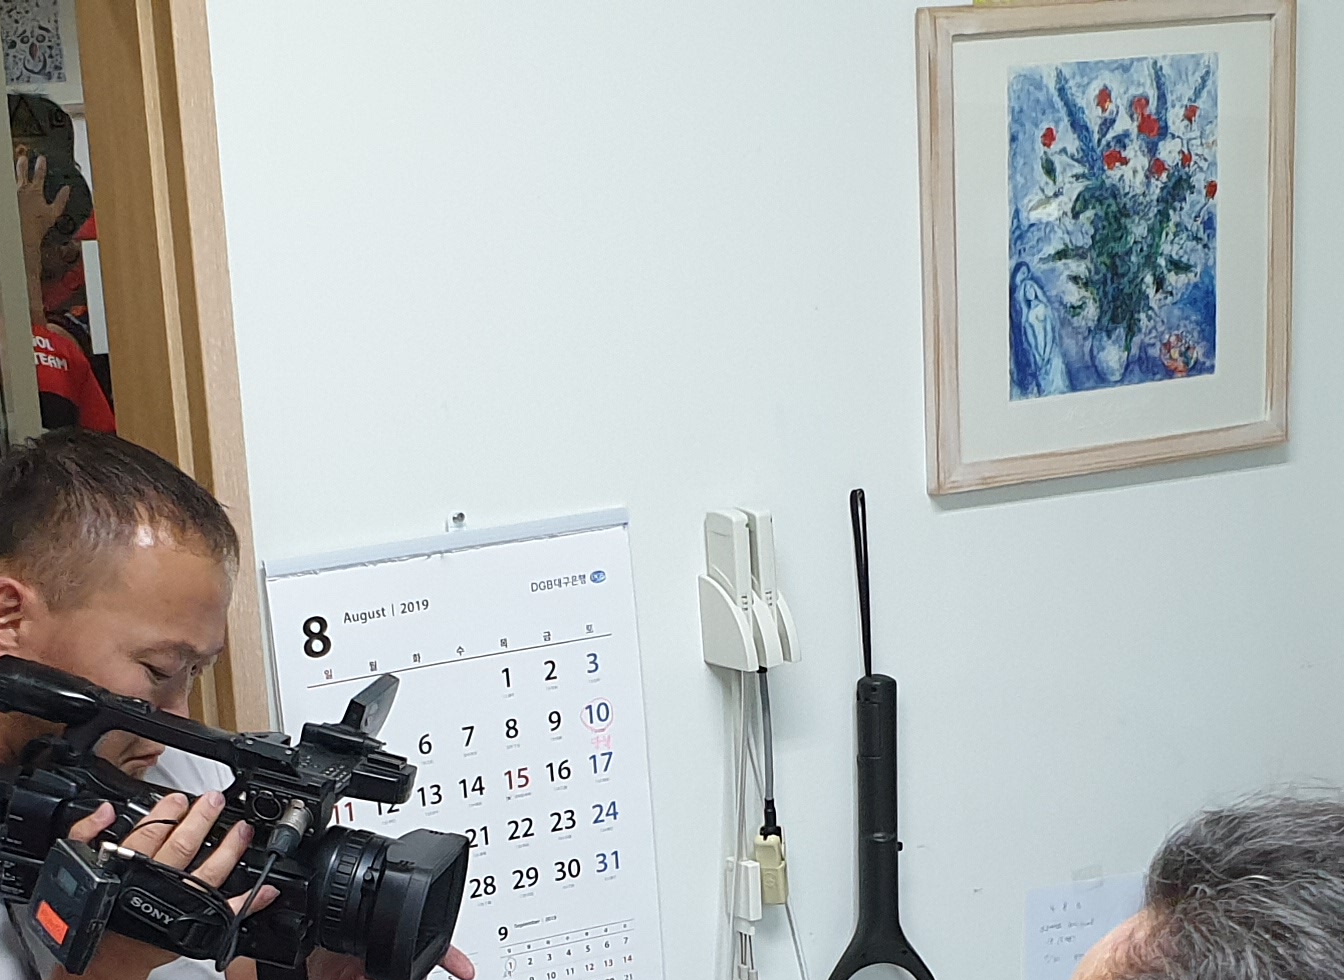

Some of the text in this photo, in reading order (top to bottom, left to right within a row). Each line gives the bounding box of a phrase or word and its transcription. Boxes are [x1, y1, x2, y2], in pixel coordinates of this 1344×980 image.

[531, 574, 586, 592] DGB대구은행
[344, 599, 429, 624] August 2019
[303, 616, 331, 658] 8
[456, 646, 465, 656] 수
[543, 631, 551, 641] 금
[501, 652, 599, 688] 1 2 3
[418, 733, 433, 755] 6
[461, 725, 475, 747] 7
[505, 718, 519, 739] 8
[548, 710, 562, 732] 9
[584, 702, 610, 725] 10
[332, 801, 354, 825] 11
[416, 784, 443, 807] 13
[458, 775, 486, 799] 14
[504, 767, 530, 790] 15
[545, 759, 572, 782] 16
[588, 751, 613, 774] 17
[465, 825, 490, 848] 21
[507, 817, 535, 841] 22
[549, 809, 577, 833] 23
[592, 800, 619, 825] 24
[469, 875, 497, 899] 28
[512, 866, 539, 890] 29
[554, 858, 581, 882] 30
[595, 850, 620, 873] 31
[130, 896, 174, 925] SONY
[497, 926, 509, 941] 9
